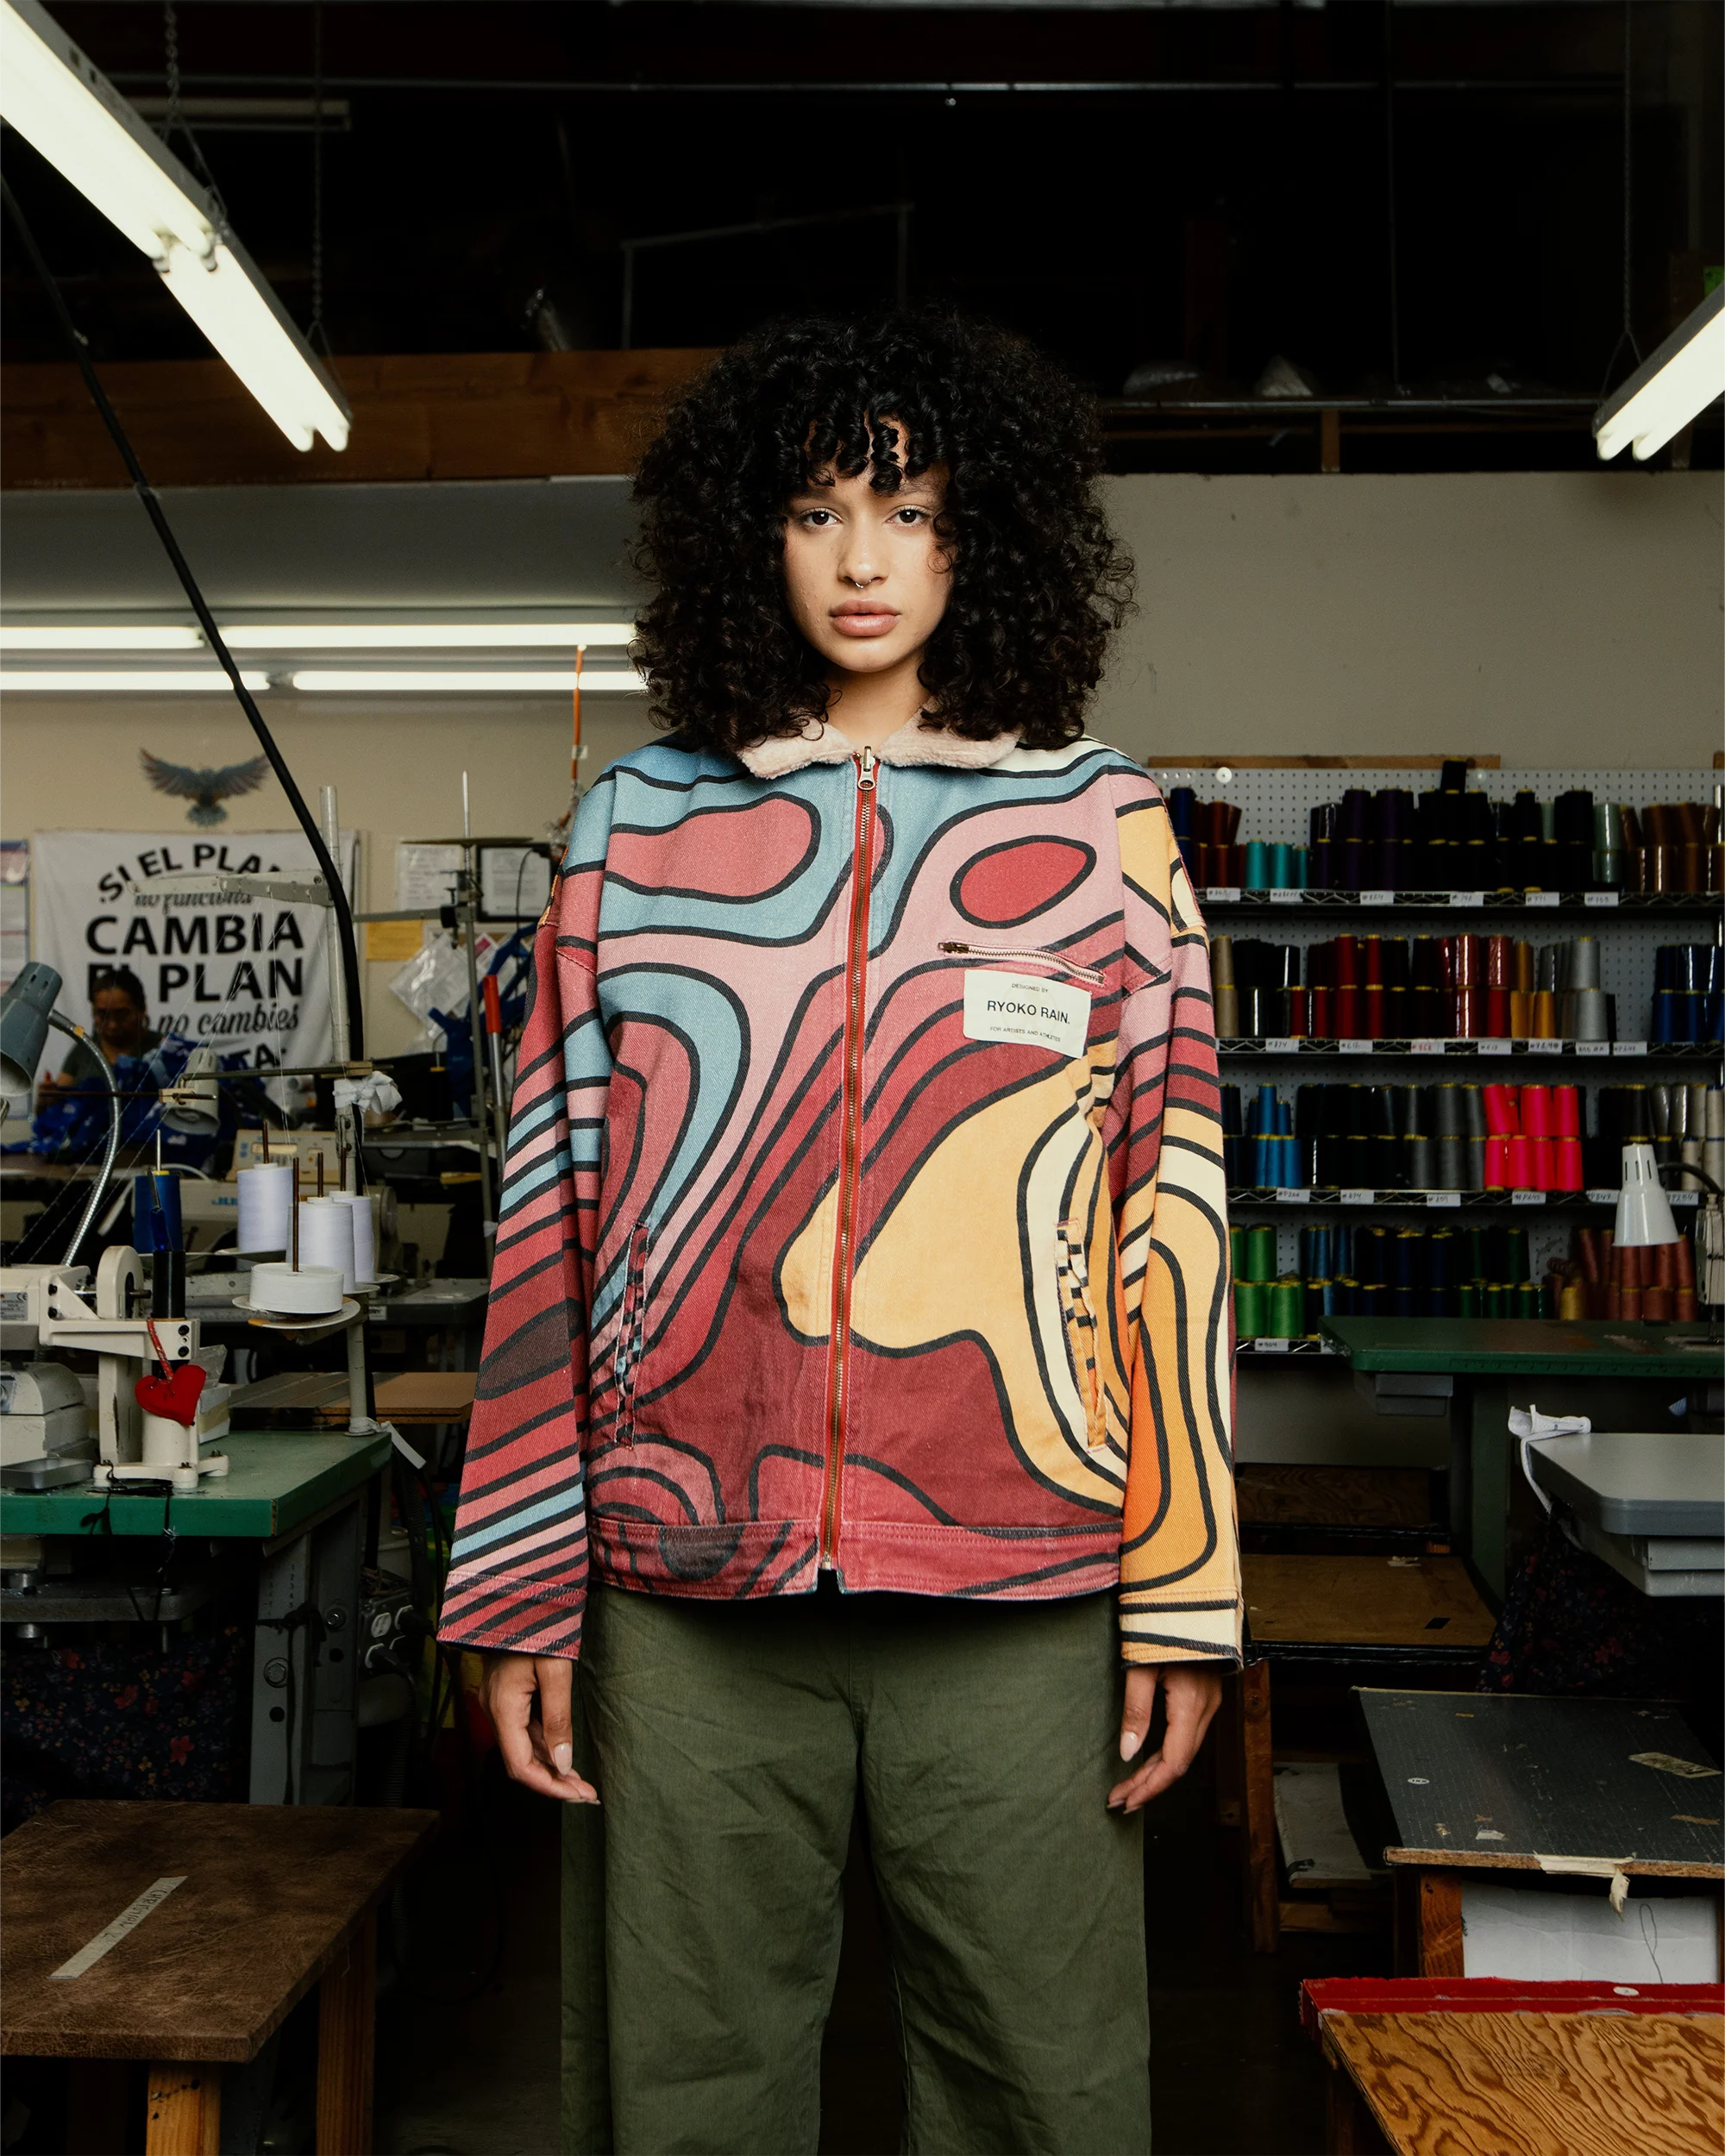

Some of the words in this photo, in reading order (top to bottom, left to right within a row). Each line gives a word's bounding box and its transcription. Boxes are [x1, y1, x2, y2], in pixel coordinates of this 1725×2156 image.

[137, 847, 183, 878] EL
[194, 843, 281, 874] PLA
[86, 910, 304, 956] CAMBIA
[159, 957, 303, 1003] PLAN
[1012, 983, 1040, 992] DESIGNED
[198, 1002, 299, 1035] cambies
[987, 1000, 1037, 1016] RYOKO
[1040, 1006, 1070, 1025] RAIN.
[1039, 1031, 1061, 1043] ATHLETES
